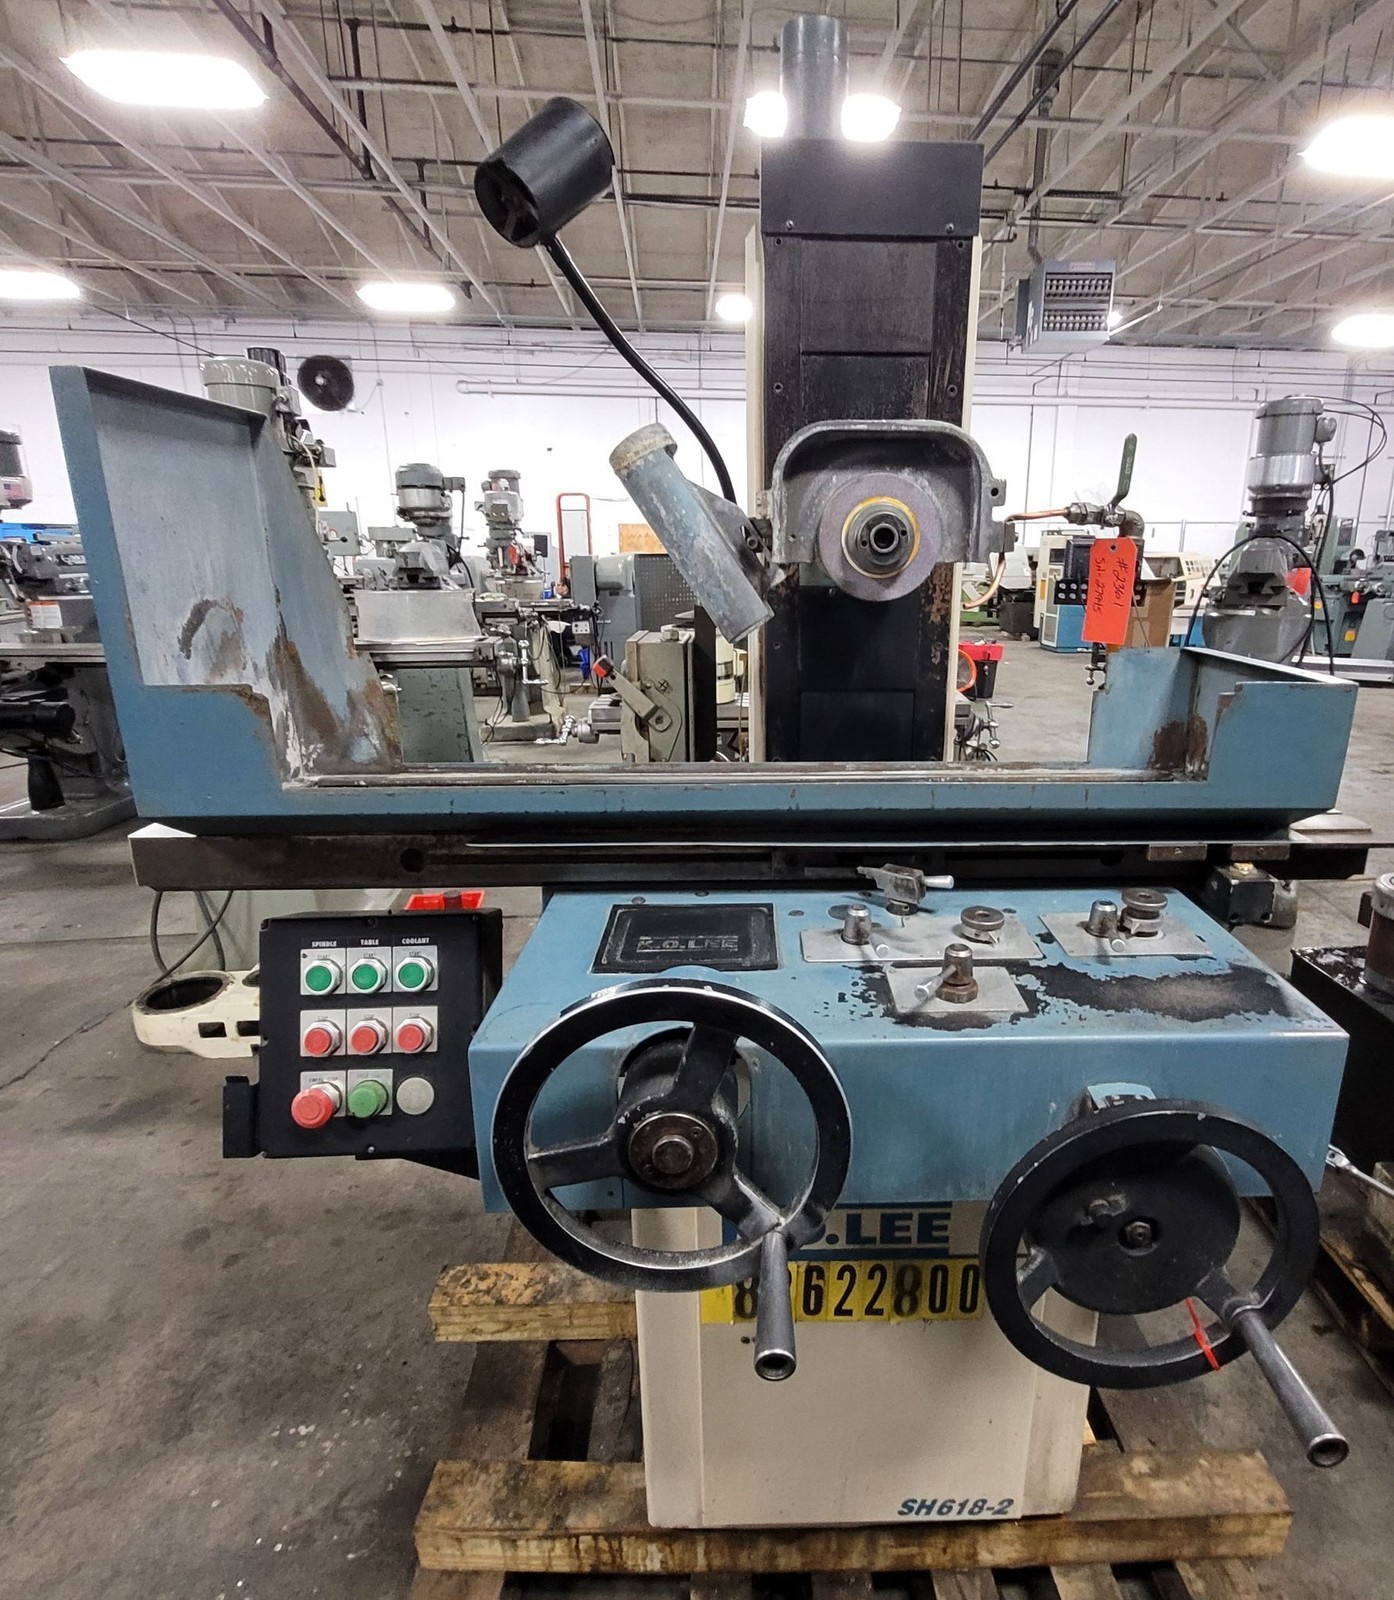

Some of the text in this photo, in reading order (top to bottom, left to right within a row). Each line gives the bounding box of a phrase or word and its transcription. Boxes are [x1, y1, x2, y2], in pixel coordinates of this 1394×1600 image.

[311, 940, 338, 948] SPINDLE
[401, 937, 430, 945] COOLANT
[735, 1263, 980, 1318] 8622800
[897, 1498, 1015, 1516] SH618-2
